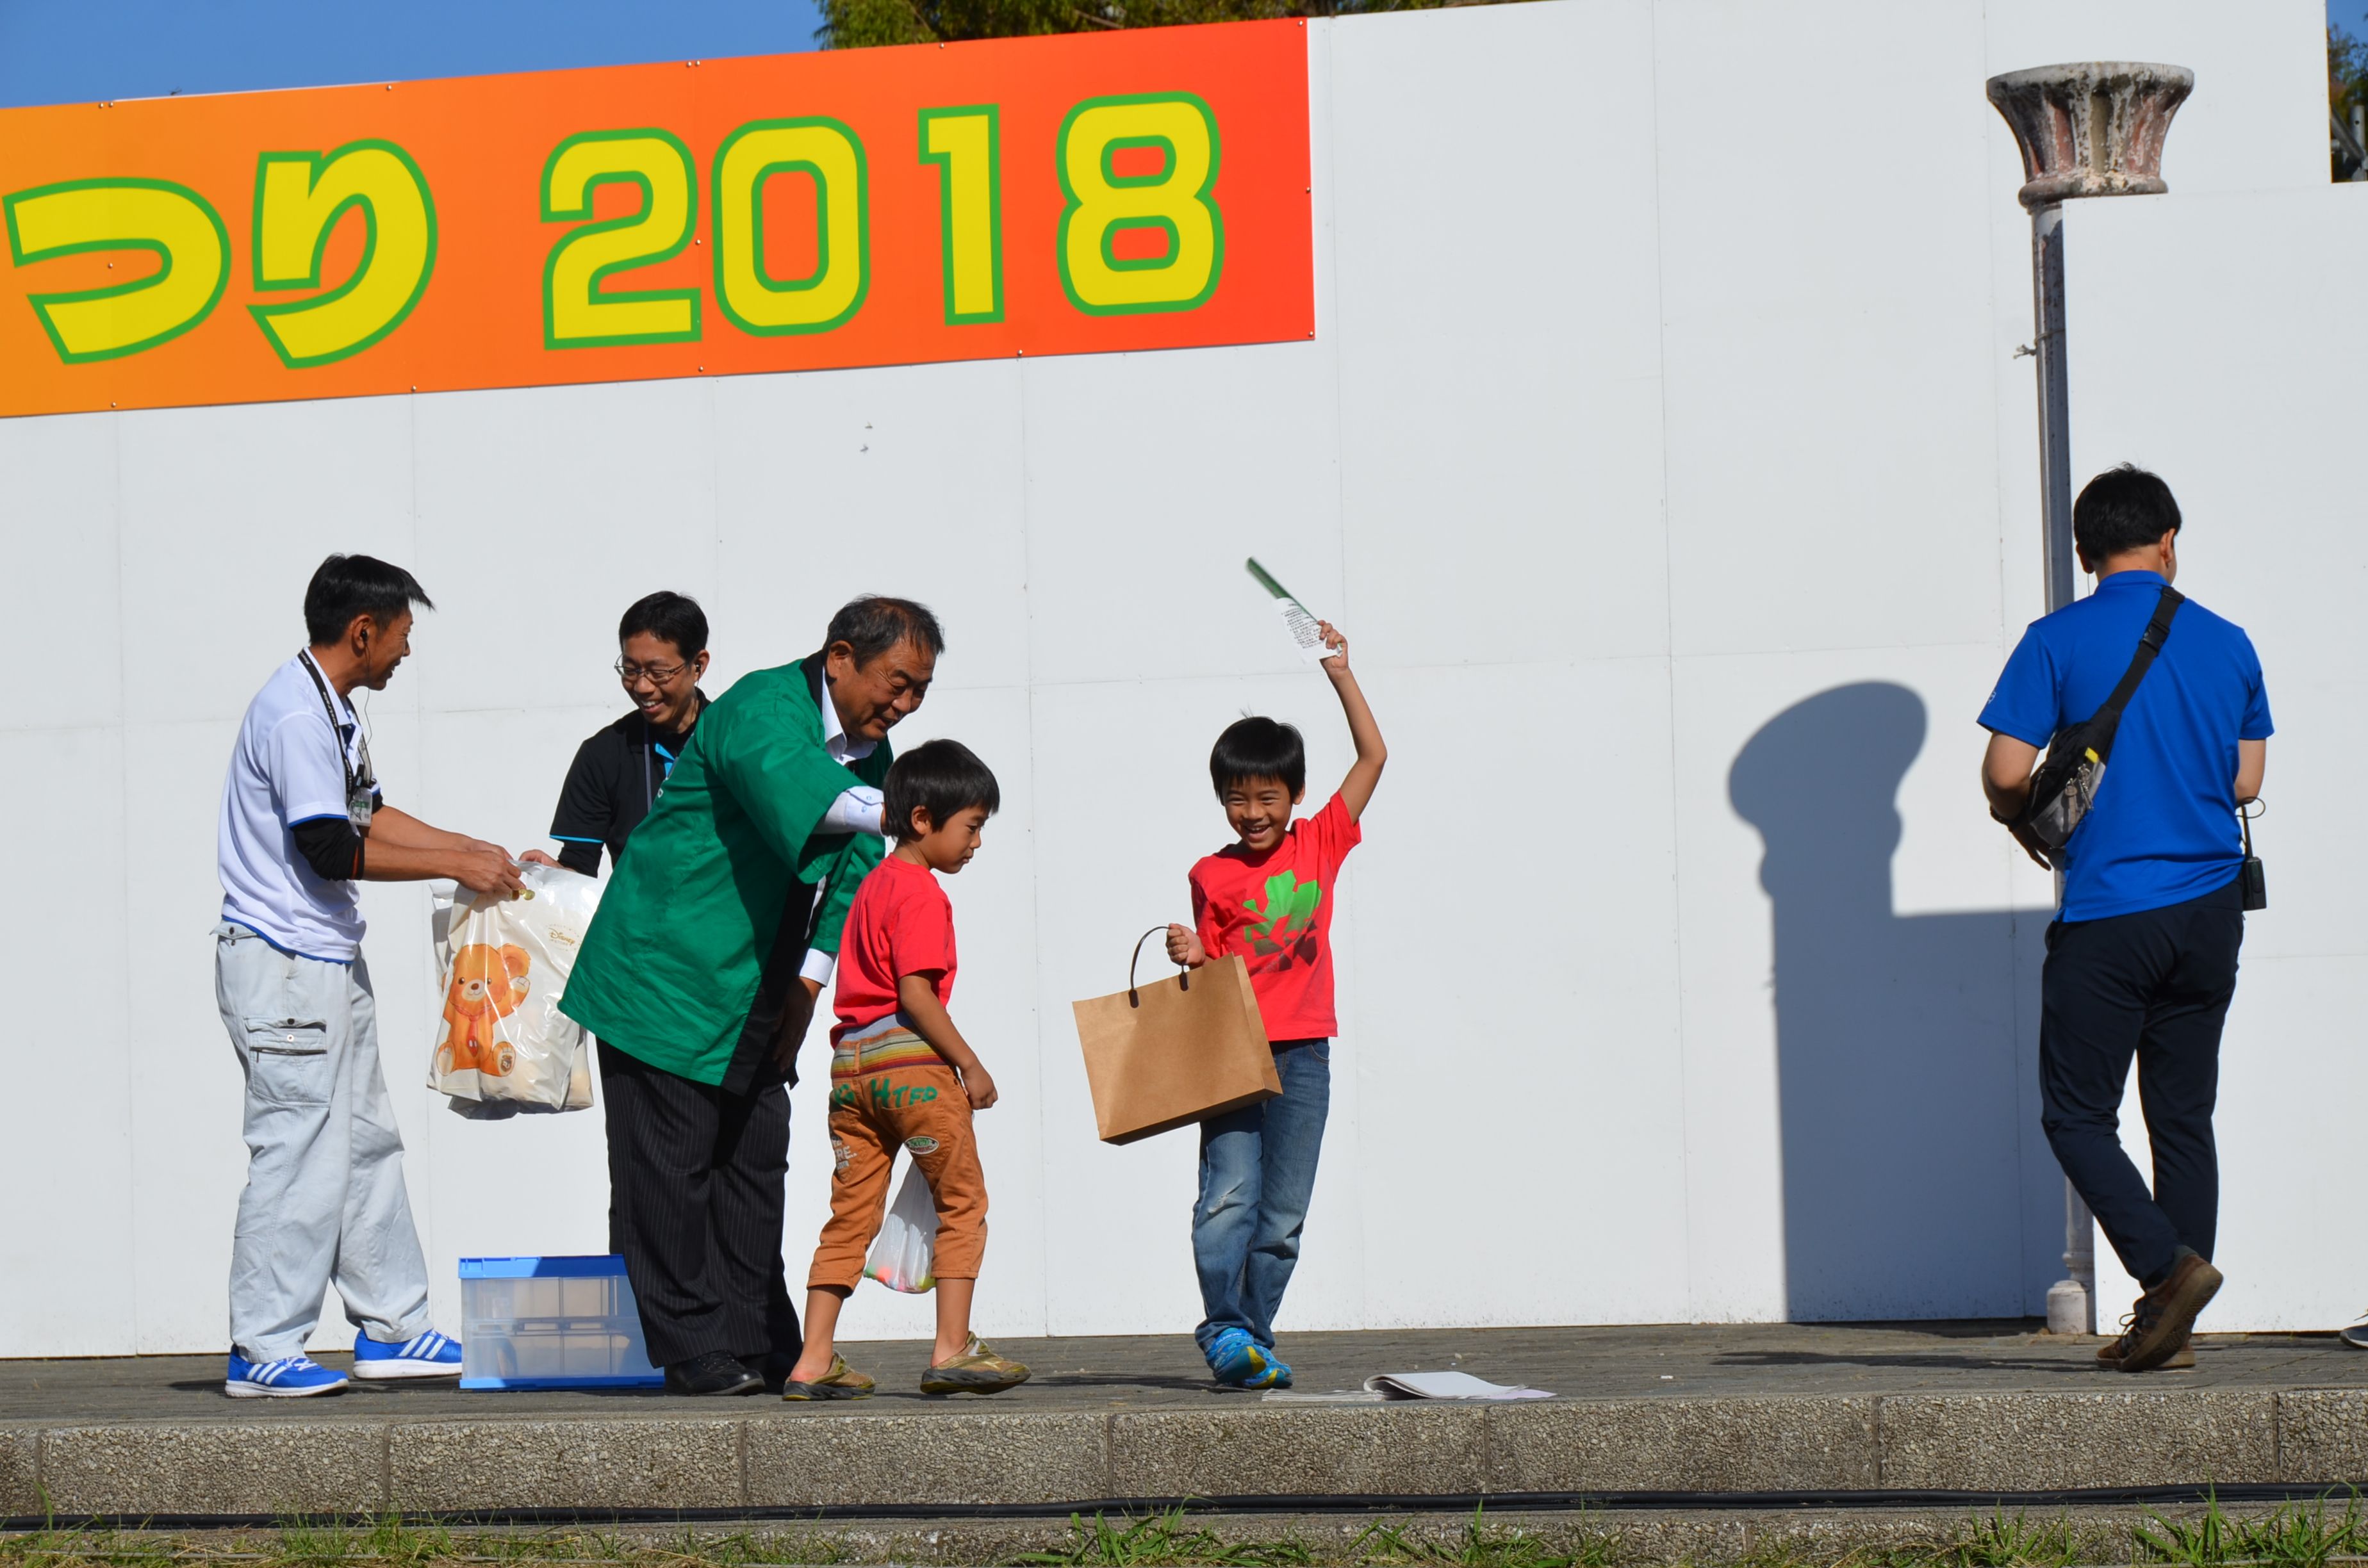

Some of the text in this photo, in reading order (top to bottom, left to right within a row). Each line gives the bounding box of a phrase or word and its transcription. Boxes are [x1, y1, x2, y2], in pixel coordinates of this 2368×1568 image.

[2, 90, 1225, 369] つり 2018
[322, 691, 338, 728] Australia
[548, 927, 575, 946] Disney
